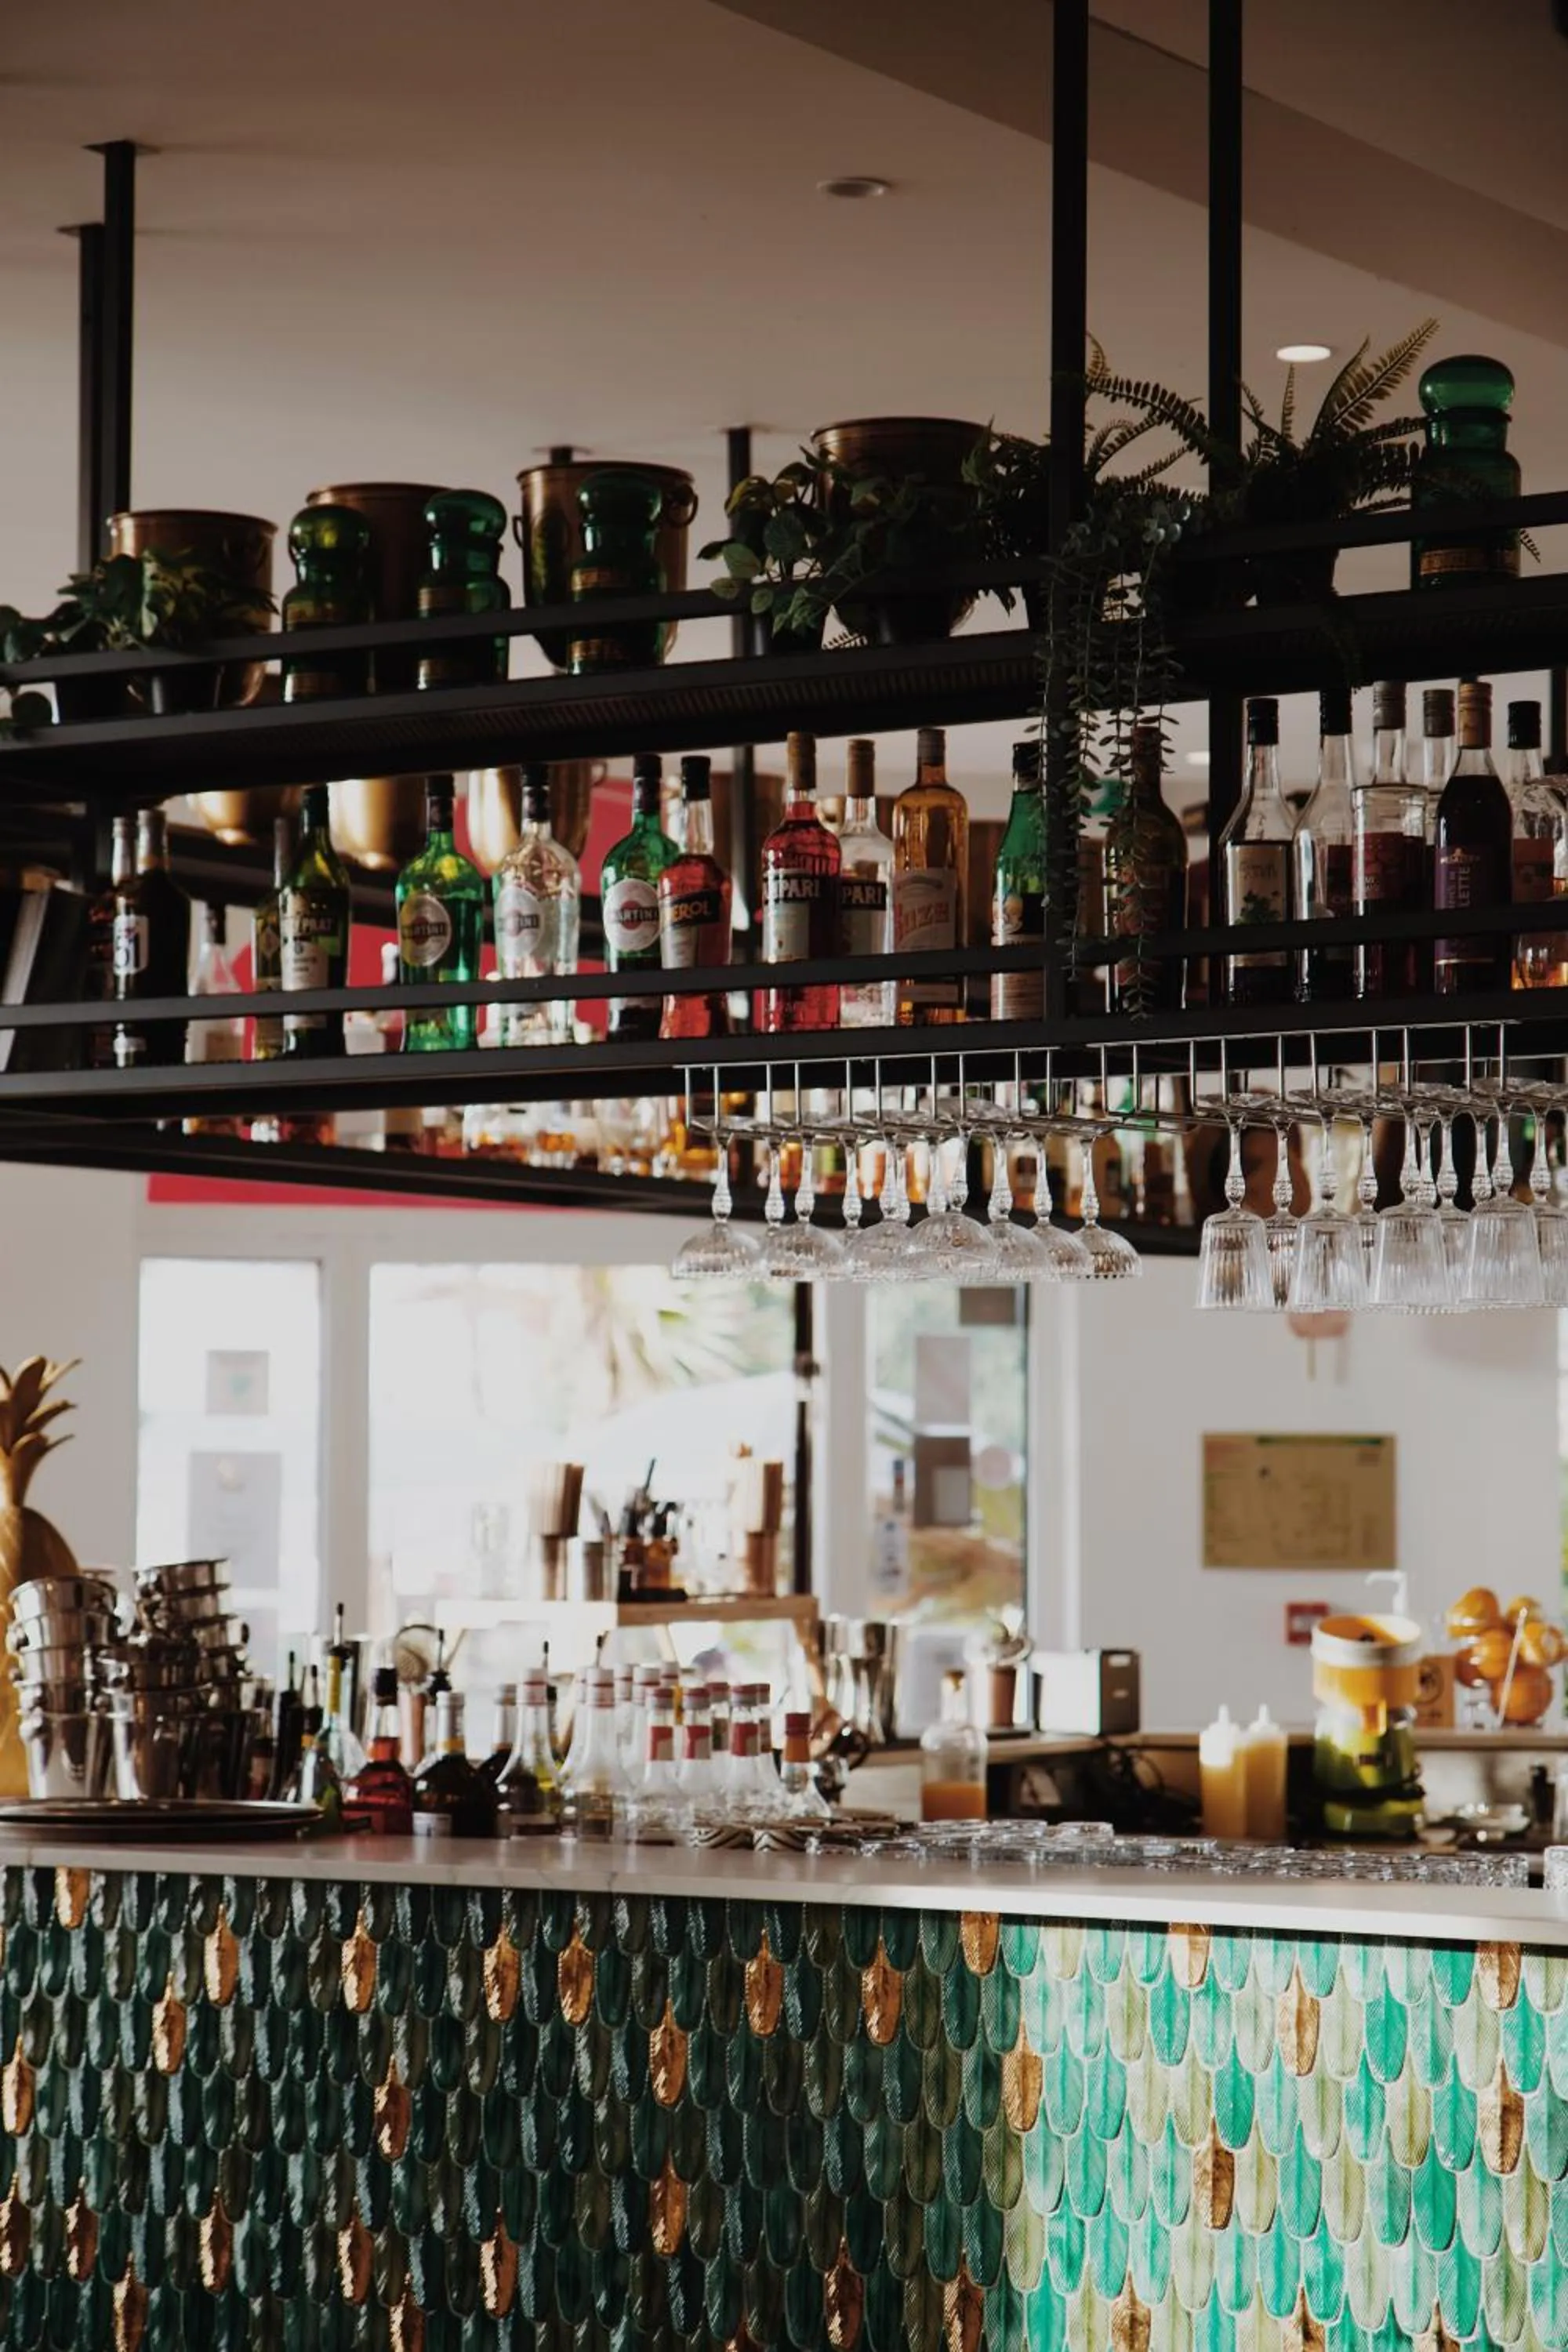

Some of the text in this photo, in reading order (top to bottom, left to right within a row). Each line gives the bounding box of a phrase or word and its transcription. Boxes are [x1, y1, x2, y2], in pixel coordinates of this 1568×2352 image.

[842, 884, 883, 905] PARI
[1458, 866, 1471, 908] LETTE
[667, 900, 712, 924] EROL
